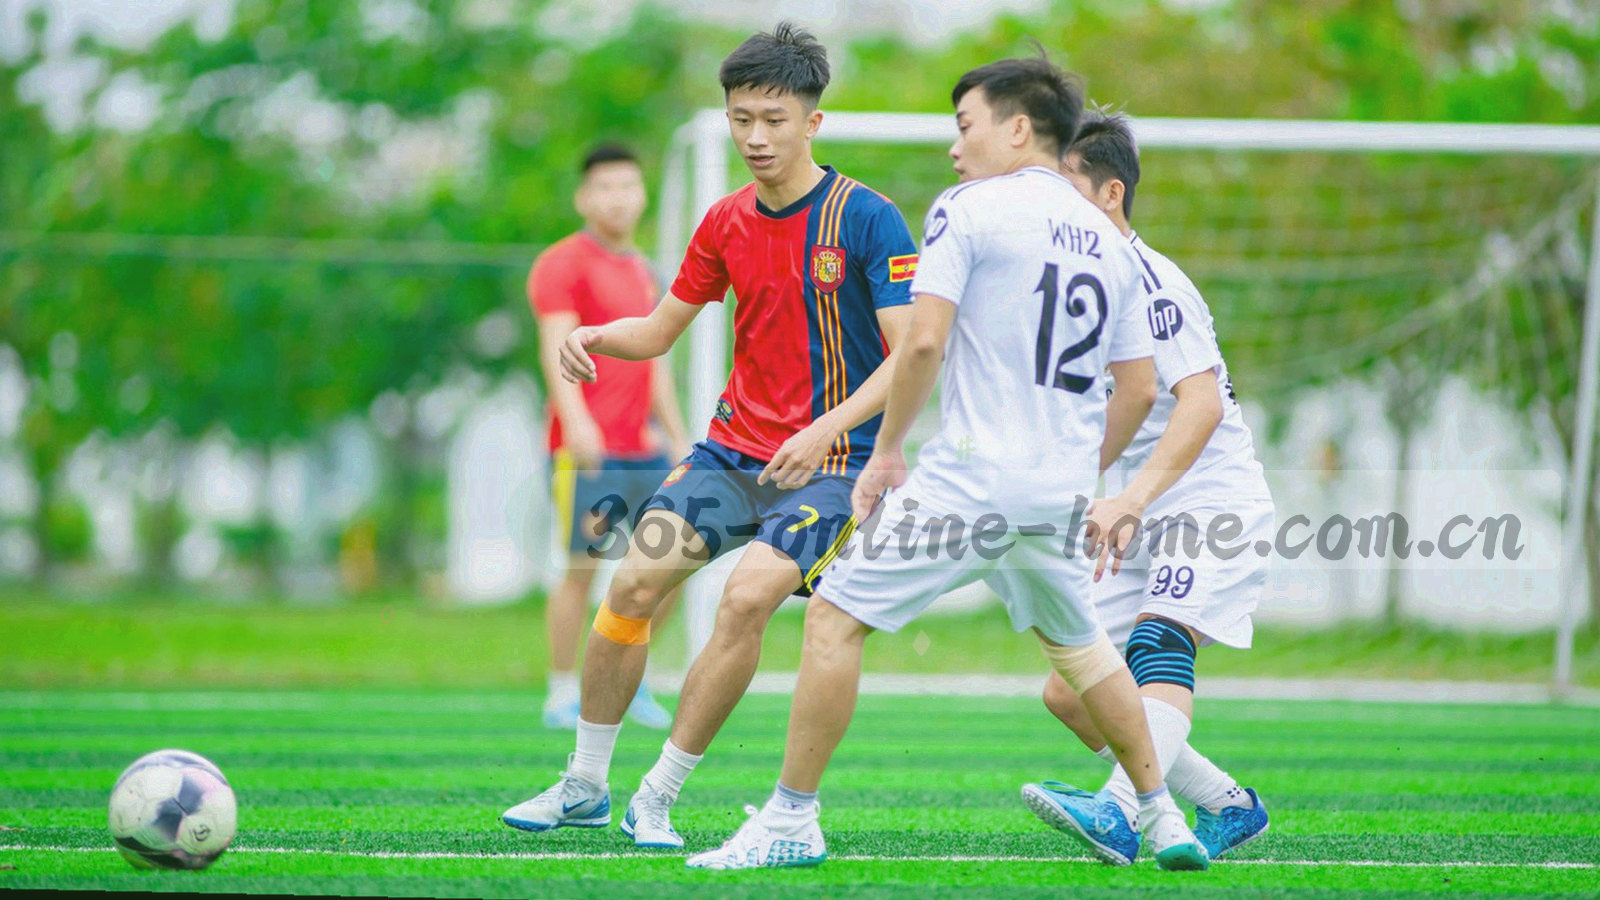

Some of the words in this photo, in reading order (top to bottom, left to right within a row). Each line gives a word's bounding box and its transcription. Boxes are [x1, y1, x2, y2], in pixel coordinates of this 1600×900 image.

[1048, 217, 1102, 260] WH2
[1033, 262, 1109, 395] 12
[1149, 299, 1180, 340] hp
[787, 504, 820, 533] 7
[1150, 564, 1196, 600] 99
